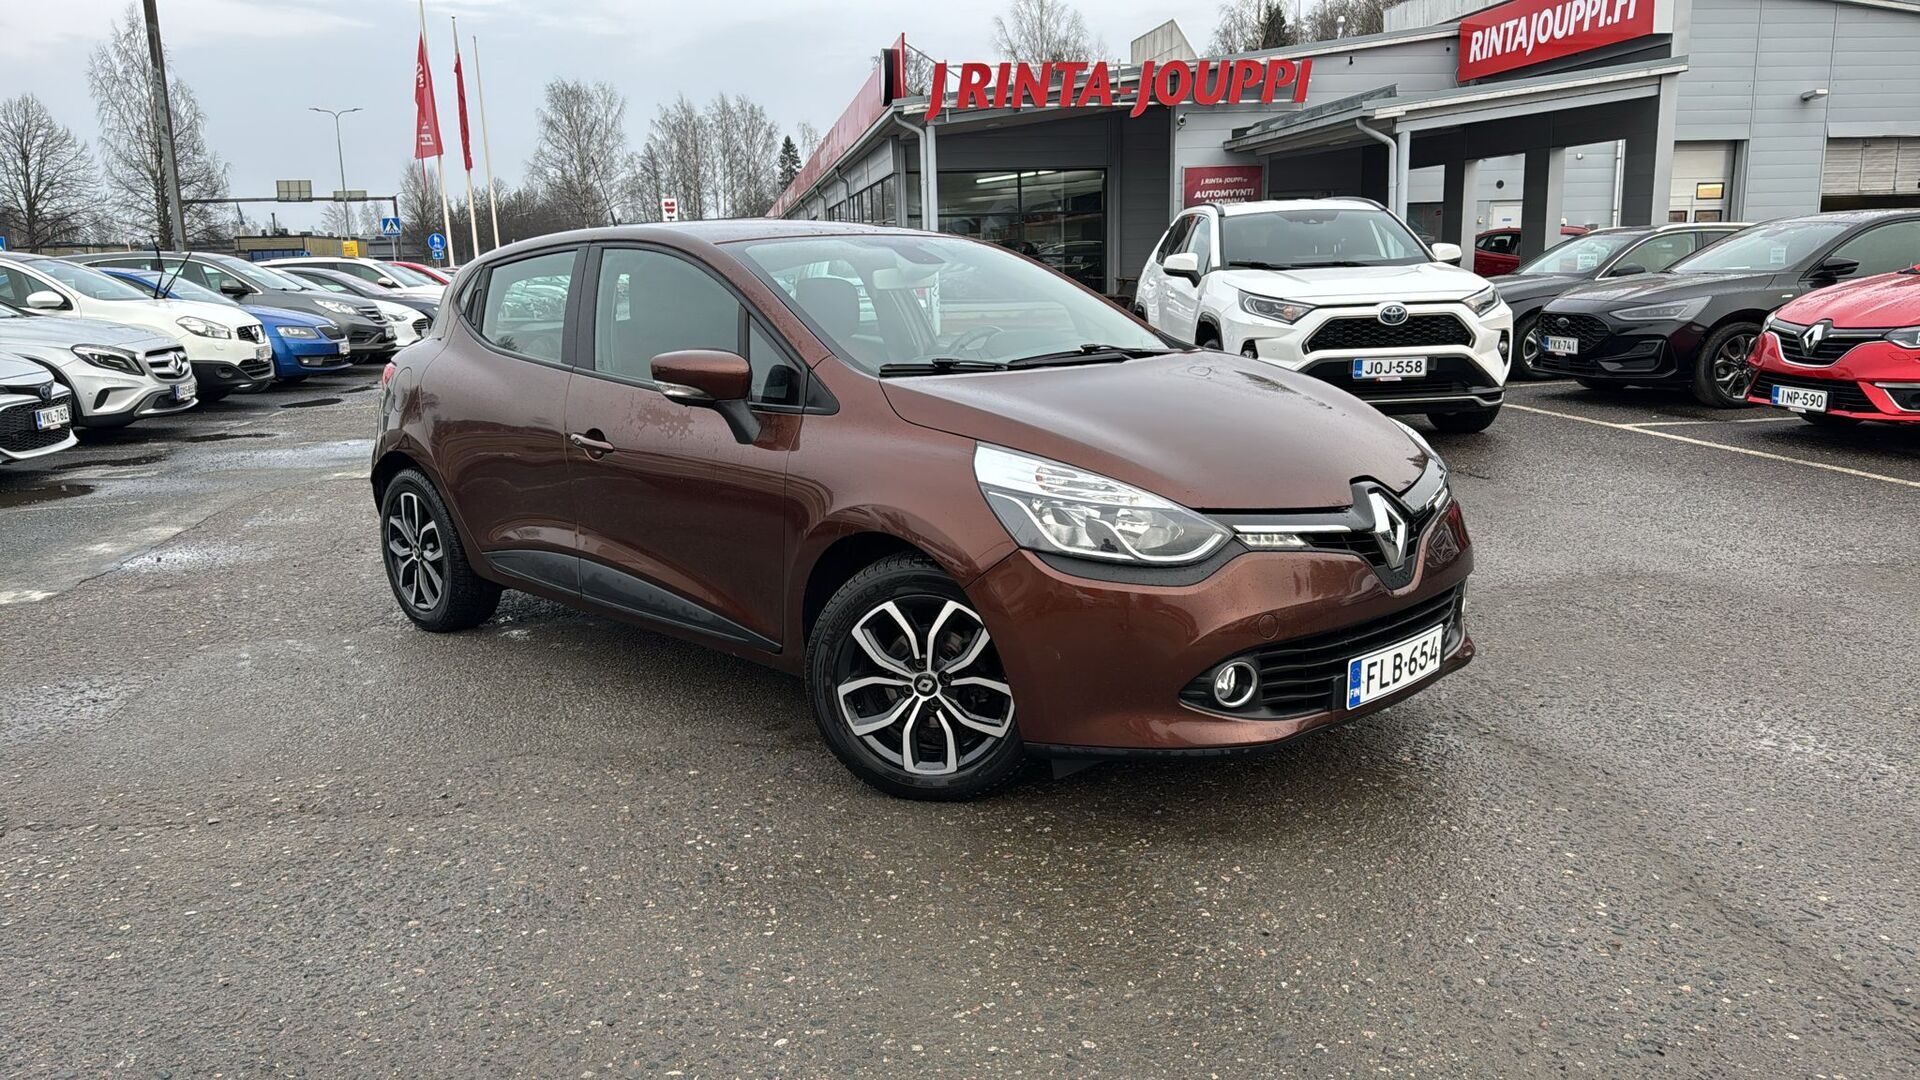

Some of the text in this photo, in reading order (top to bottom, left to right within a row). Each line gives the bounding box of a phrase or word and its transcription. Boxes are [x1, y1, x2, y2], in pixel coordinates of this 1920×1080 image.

[1194, 188, 1254, 199] AUTOMYYNTI
[1365, 360, 1423, 375] JOJ-558
[1781, 389, 1823, 408] INP-590
[42, 408, 68, 427] YKL-762
[1366, 636, 1438, 695] FLB-654
